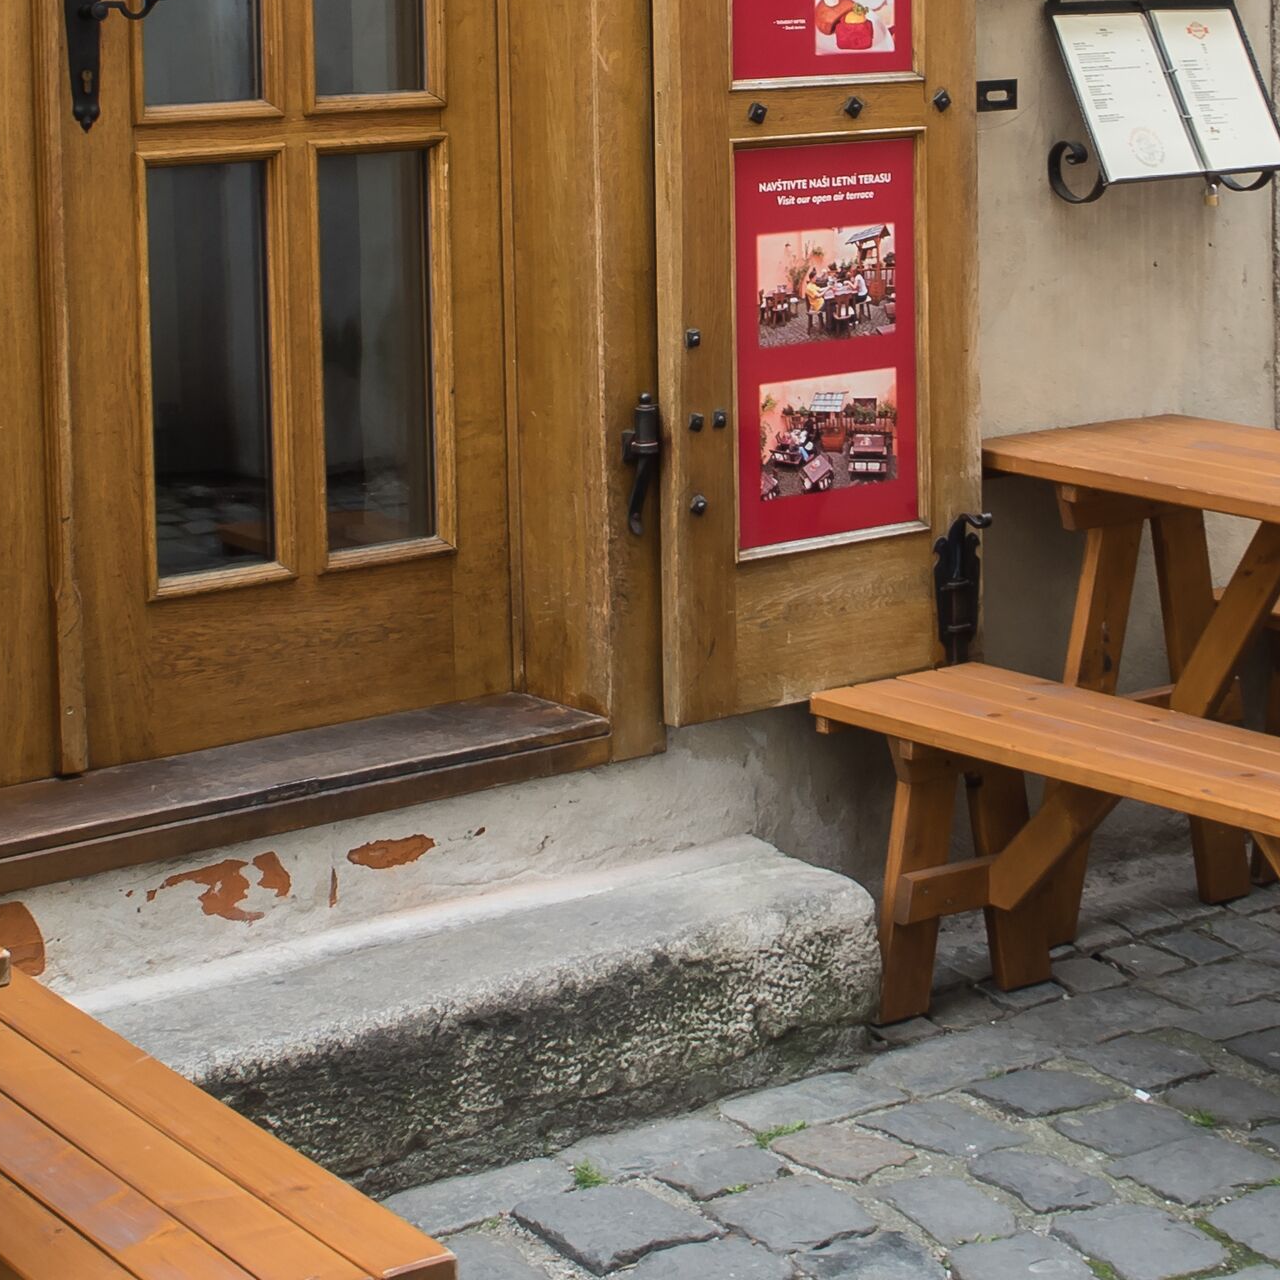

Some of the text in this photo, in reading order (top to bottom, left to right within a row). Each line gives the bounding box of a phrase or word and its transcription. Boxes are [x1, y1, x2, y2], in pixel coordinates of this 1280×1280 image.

[758, 172, 892, 193] NAVŠTIVTE NAŠI LETNÍ TERASU
[777, 189, 875, 206] Visit our open air terrace
